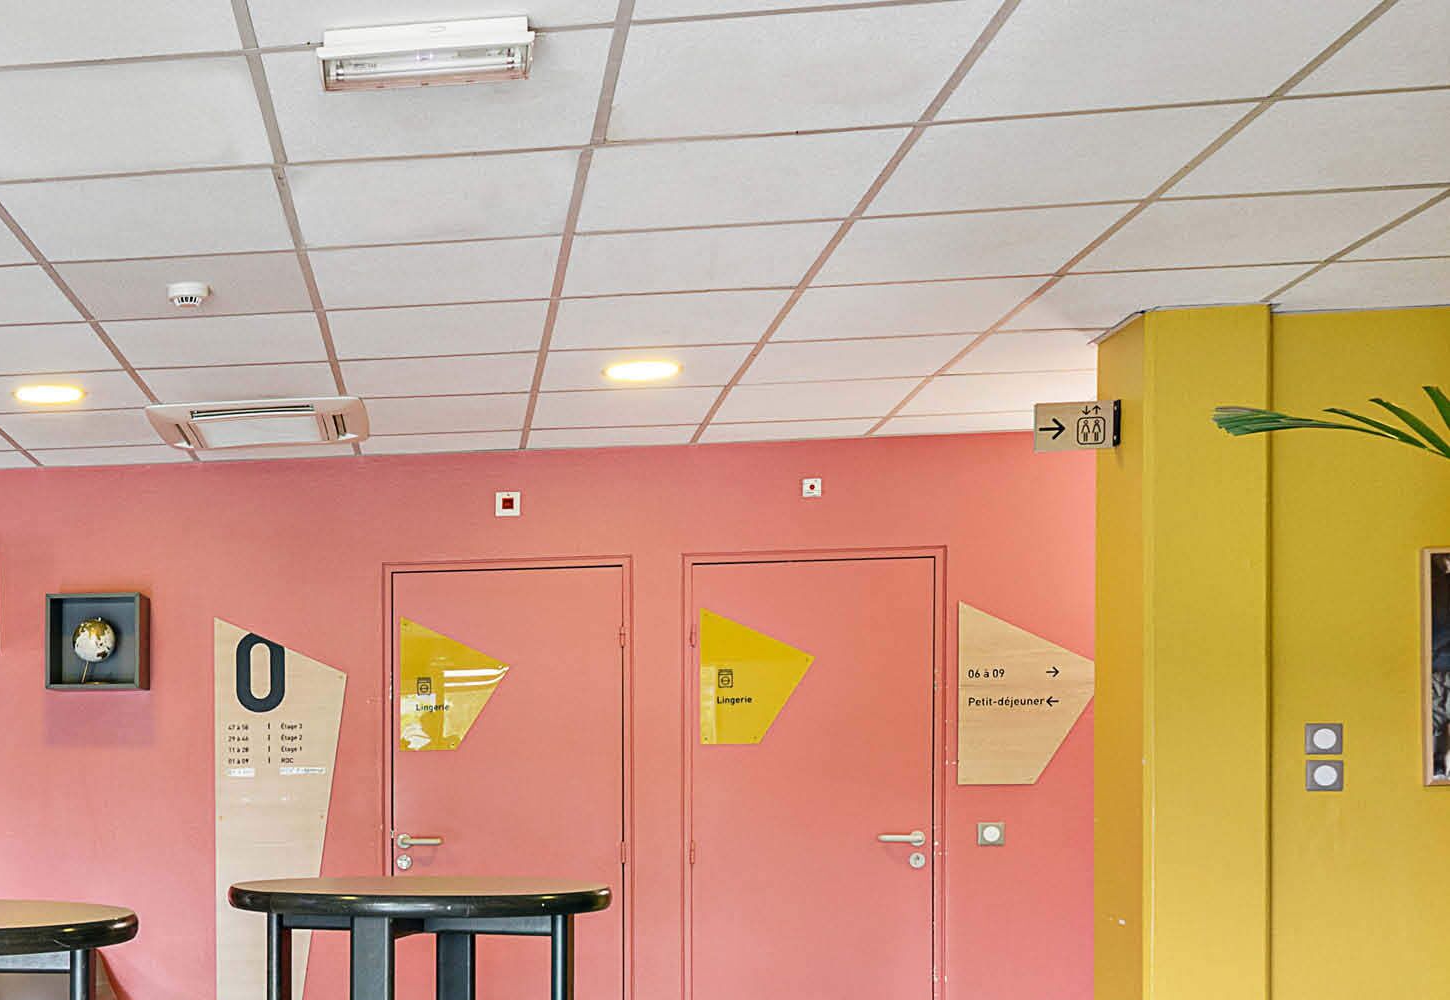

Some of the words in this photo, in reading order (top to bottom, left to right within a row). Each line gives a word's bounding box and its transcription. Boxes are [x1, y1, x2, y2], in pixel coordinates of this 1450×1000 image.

[968, 669, 980, 678] 06
[983, 669, 989, 678] à
[992, 669, 1005, 678] 09
[716, 696, 752, 706] Lingerie
[968, 697, 1045, 708] Petit-déjeuner
[415, 703, 450, 713] Lingerie
